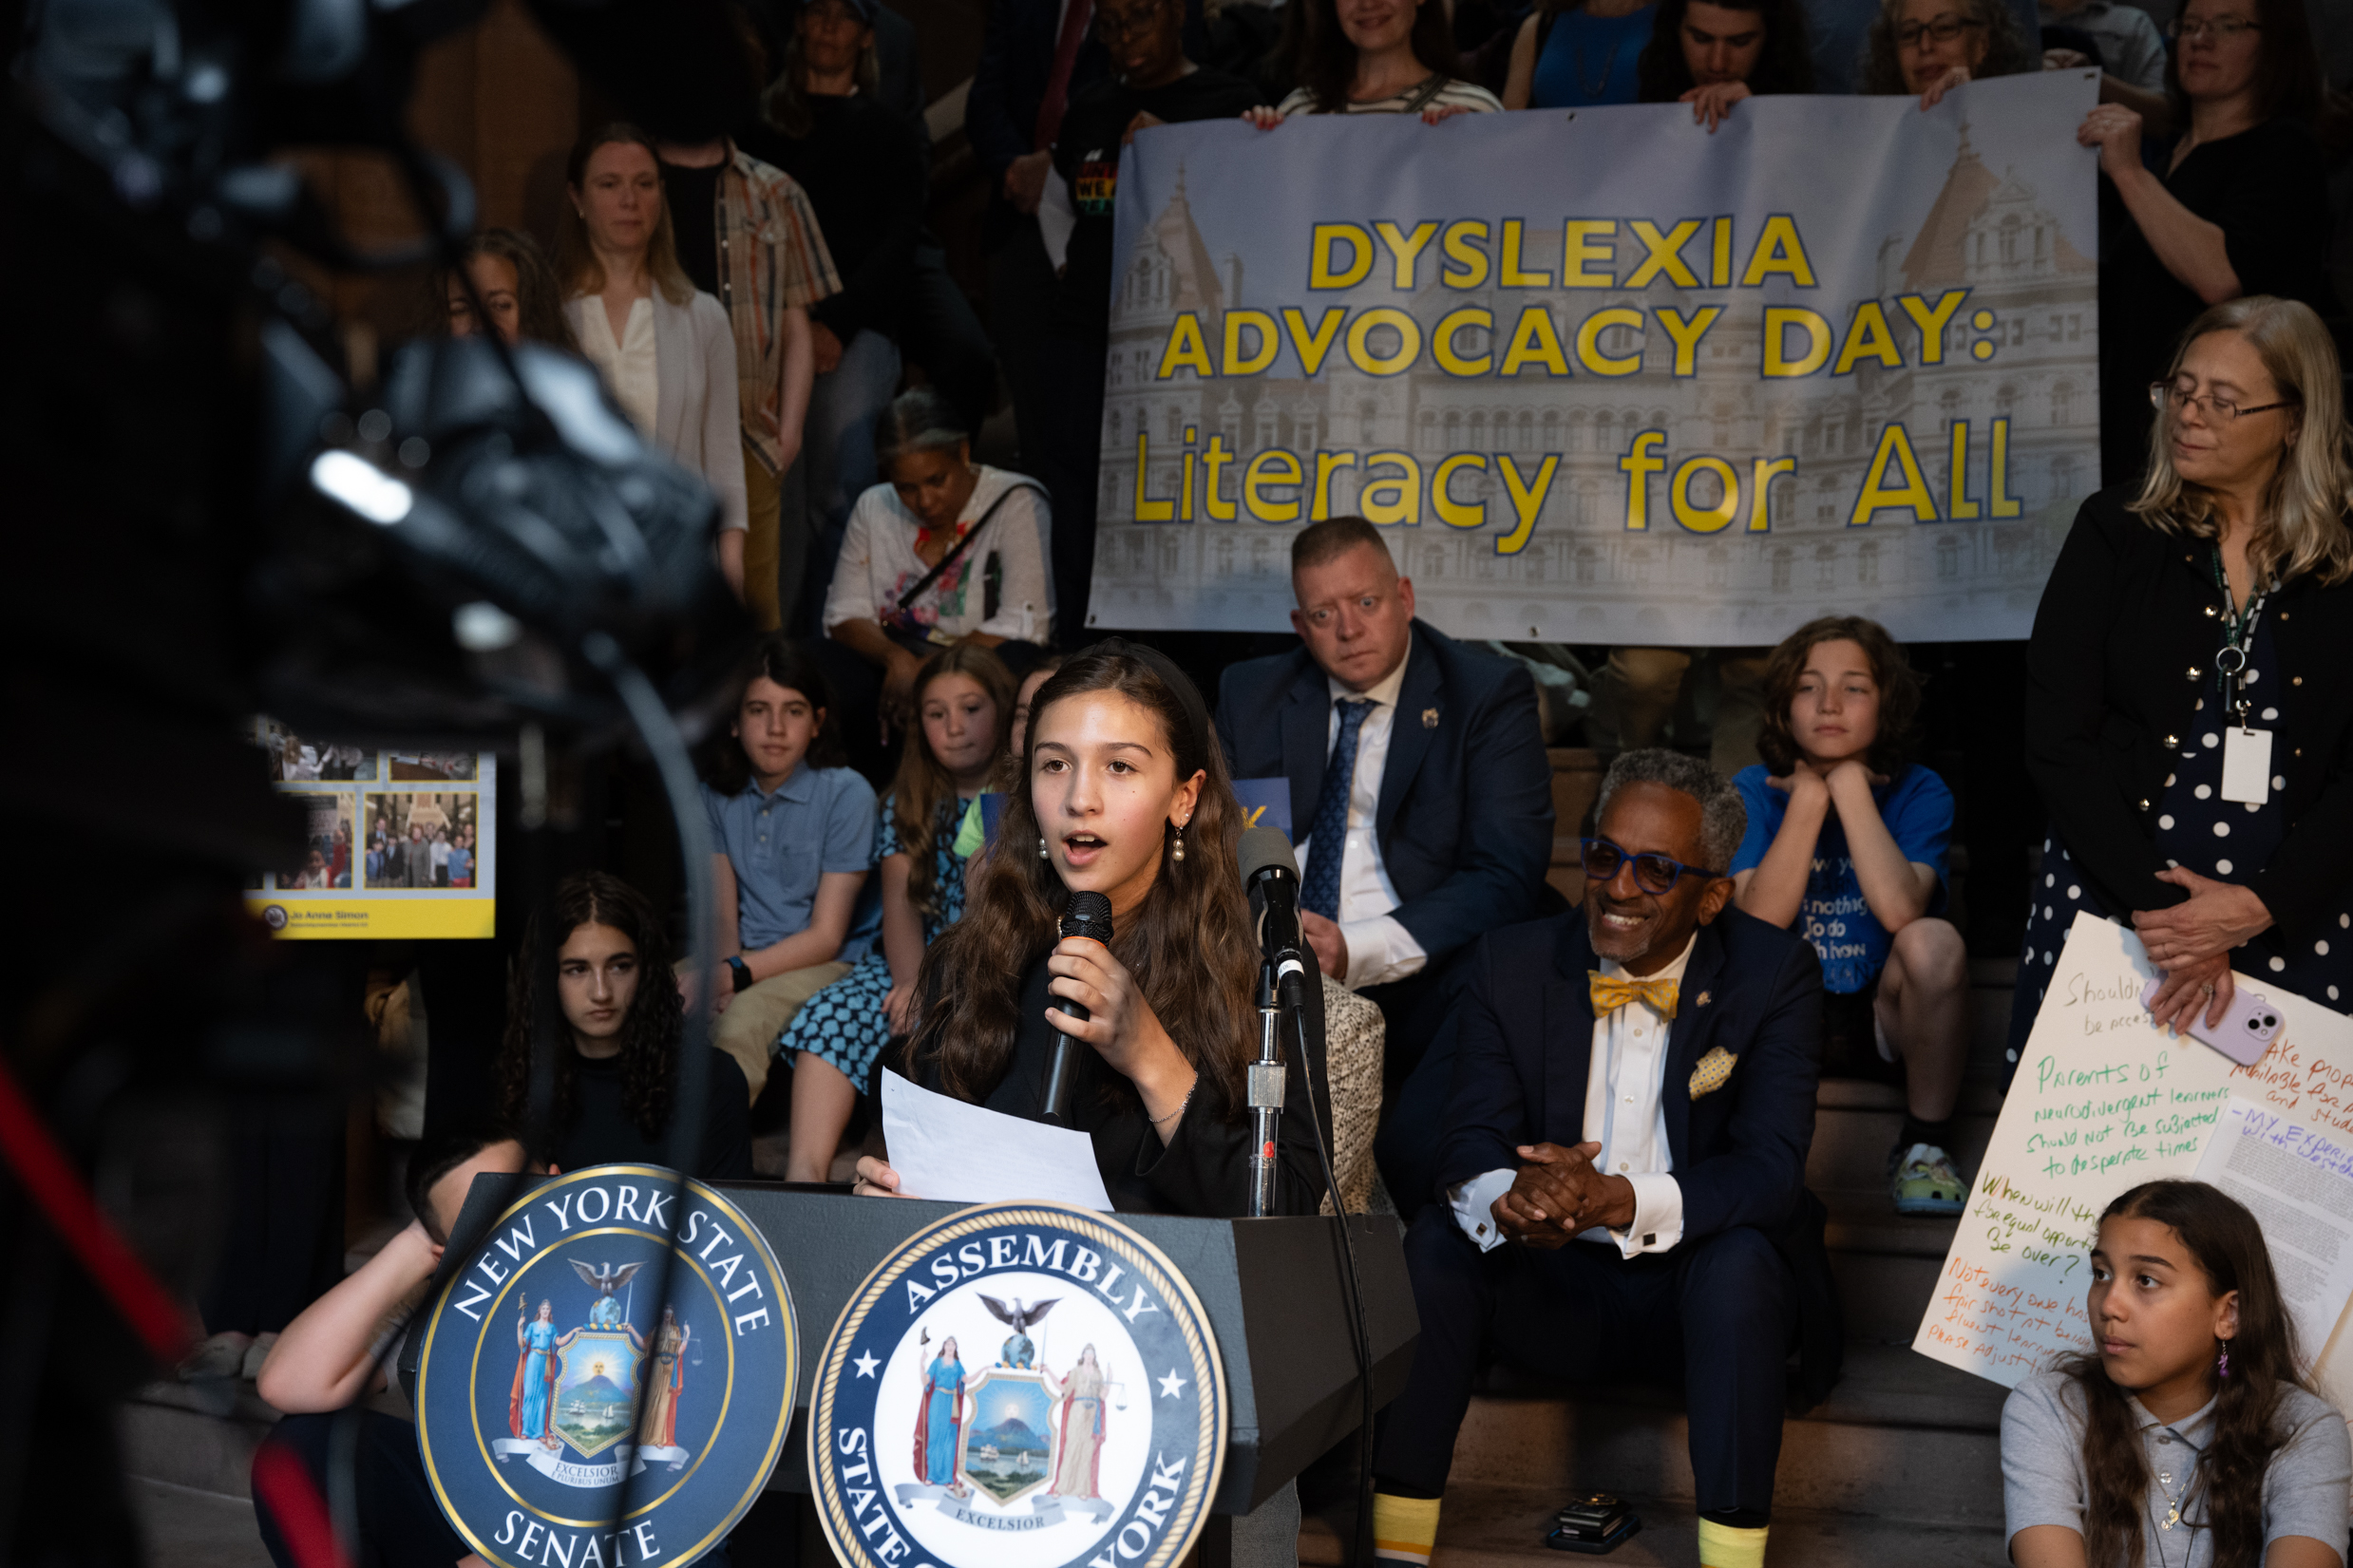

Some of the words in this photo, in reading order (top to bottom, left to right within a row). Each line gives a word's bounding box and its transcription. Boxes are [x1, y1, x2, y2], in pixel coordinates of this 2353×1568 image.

[1307, 214, 1817, 293] DYSLEXIA
[1156, 306, 1725, 380] ADVOCACY
[1760, 286, 1998, 379] DAY:
[1134, 425, 1563, 556] Literacy
[1618, 429, 1797, 533] for
[1847, 416, 2023, 527] All
[335, 911, 369, 919] Simon
[2139, 1050, 2170, 1082] of
[2266, 1090, 2300, 1109] and
[2041, 1155, 2066, 1180] to
[2154, 1137, 2198, 1159] times
[2034, 1196, 2072, 1218] will
[453, 1214, 538, 1323] NEW
[544, 1184, 677, 1232] YORK
[677, 1210, 770, 1336] STATE
[1947, 1256, 1990, 1282] Not
[903, 1234, 1160, 1324] ASSEMBLY
[555, 1462, 619, 1478] EXCELSIOR
[557, 1472, 592, 1486] PLURIBUS
[594, 1475, 619, 1485] UNUM
[838, 1426, 912, 1568] STATE
[1087, 1450, 1187, 1568] YORK
[955, 1507, 1046, 1530] EXCELSIOR
[494, 1510, 660, 1568] SENATE
